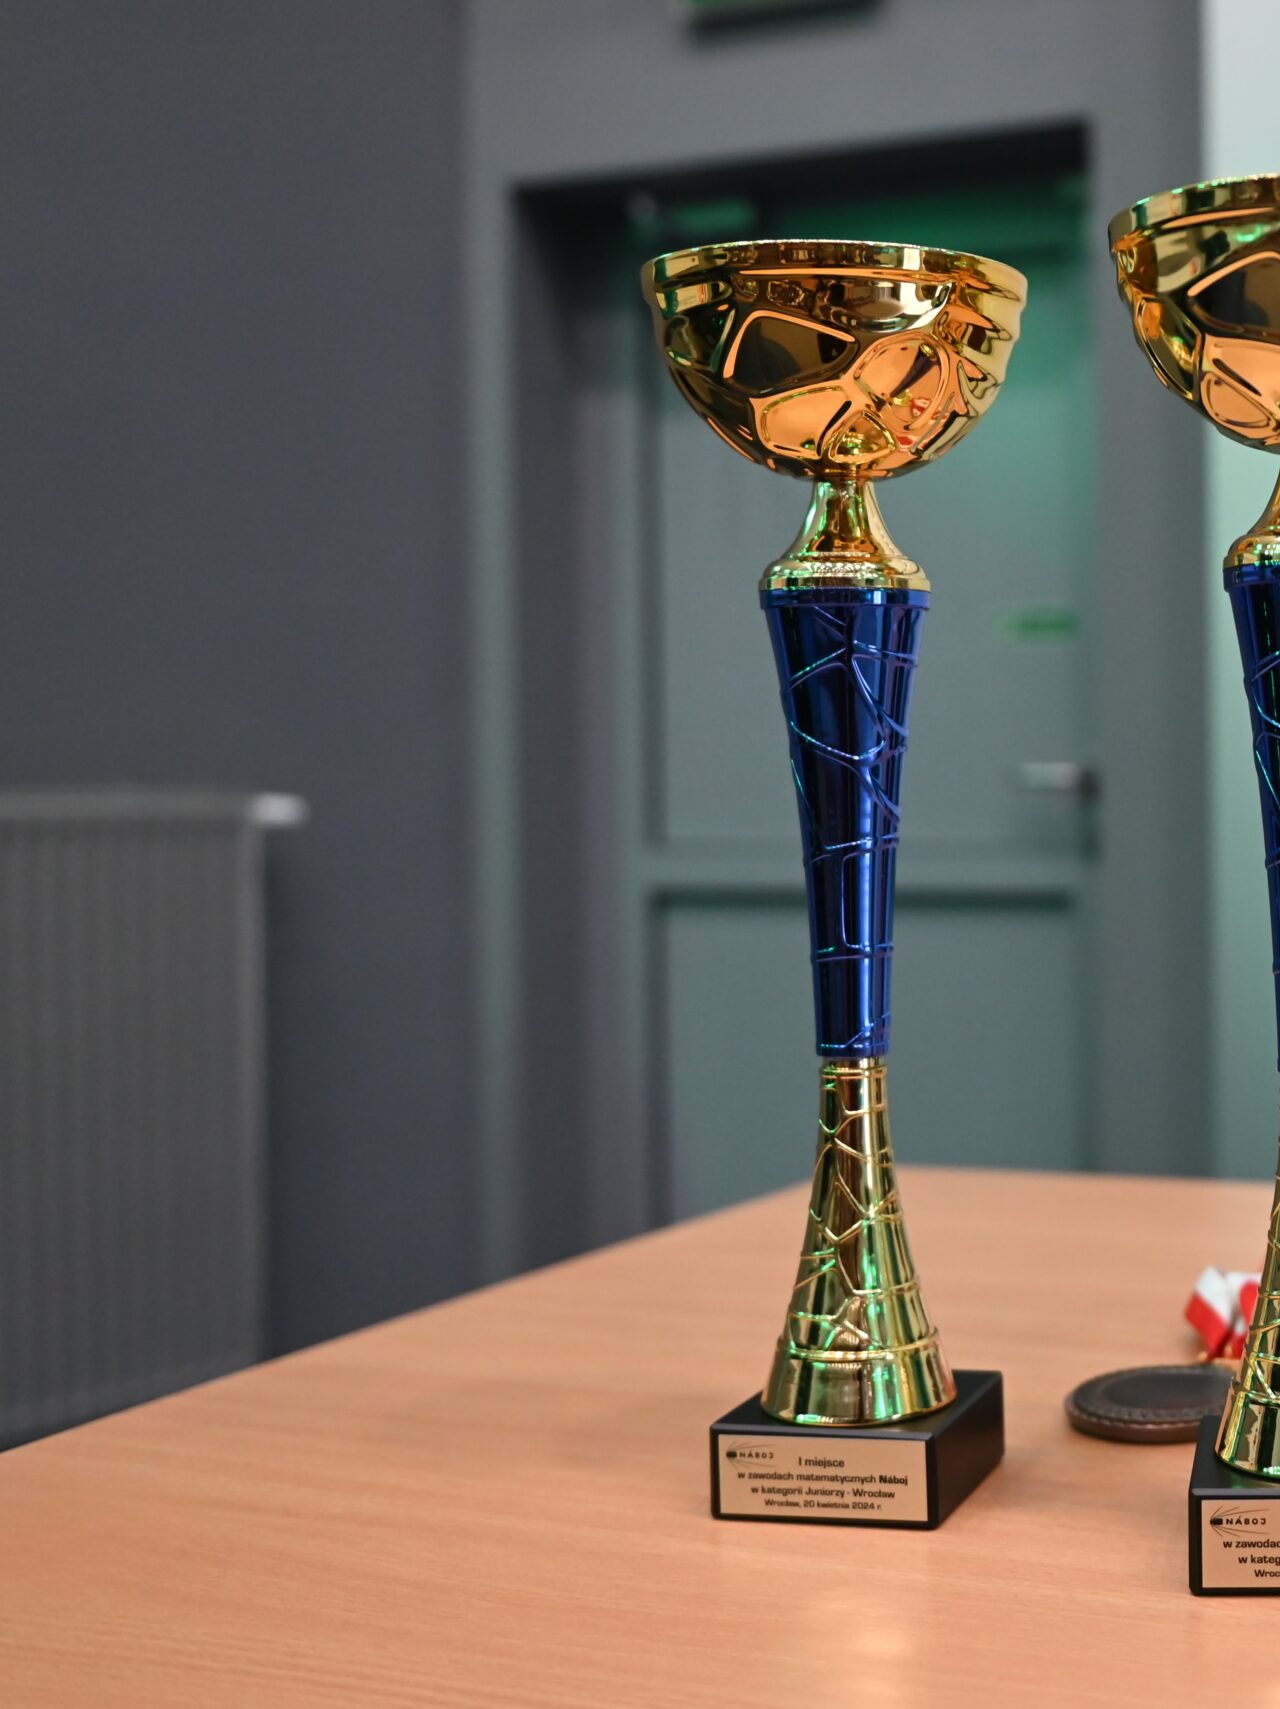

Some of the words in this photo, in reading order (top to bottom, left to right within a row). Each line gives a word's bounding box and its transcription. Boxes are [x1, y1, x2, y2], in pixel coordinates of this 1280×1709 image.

[798, 1457, 802, 1466] I
[804, 1457, 845, 1469] miejsce
[748, 1472, 794, 1481] zawodach
[796, 1473, 876, 1484] matematycznych
[879, 1475, 908, 1485] Náboj
[761, 1486, 803, 1496] kategorii
[805, 1488, 845, 1498] Juniorzy
[852, 1489, 895, 1498] Wrocław
[803, 1500, 815, 1508] 20
[817, 1501, 849, 1509] kwietnia
[852, 1502, 875, 1510] 2024
